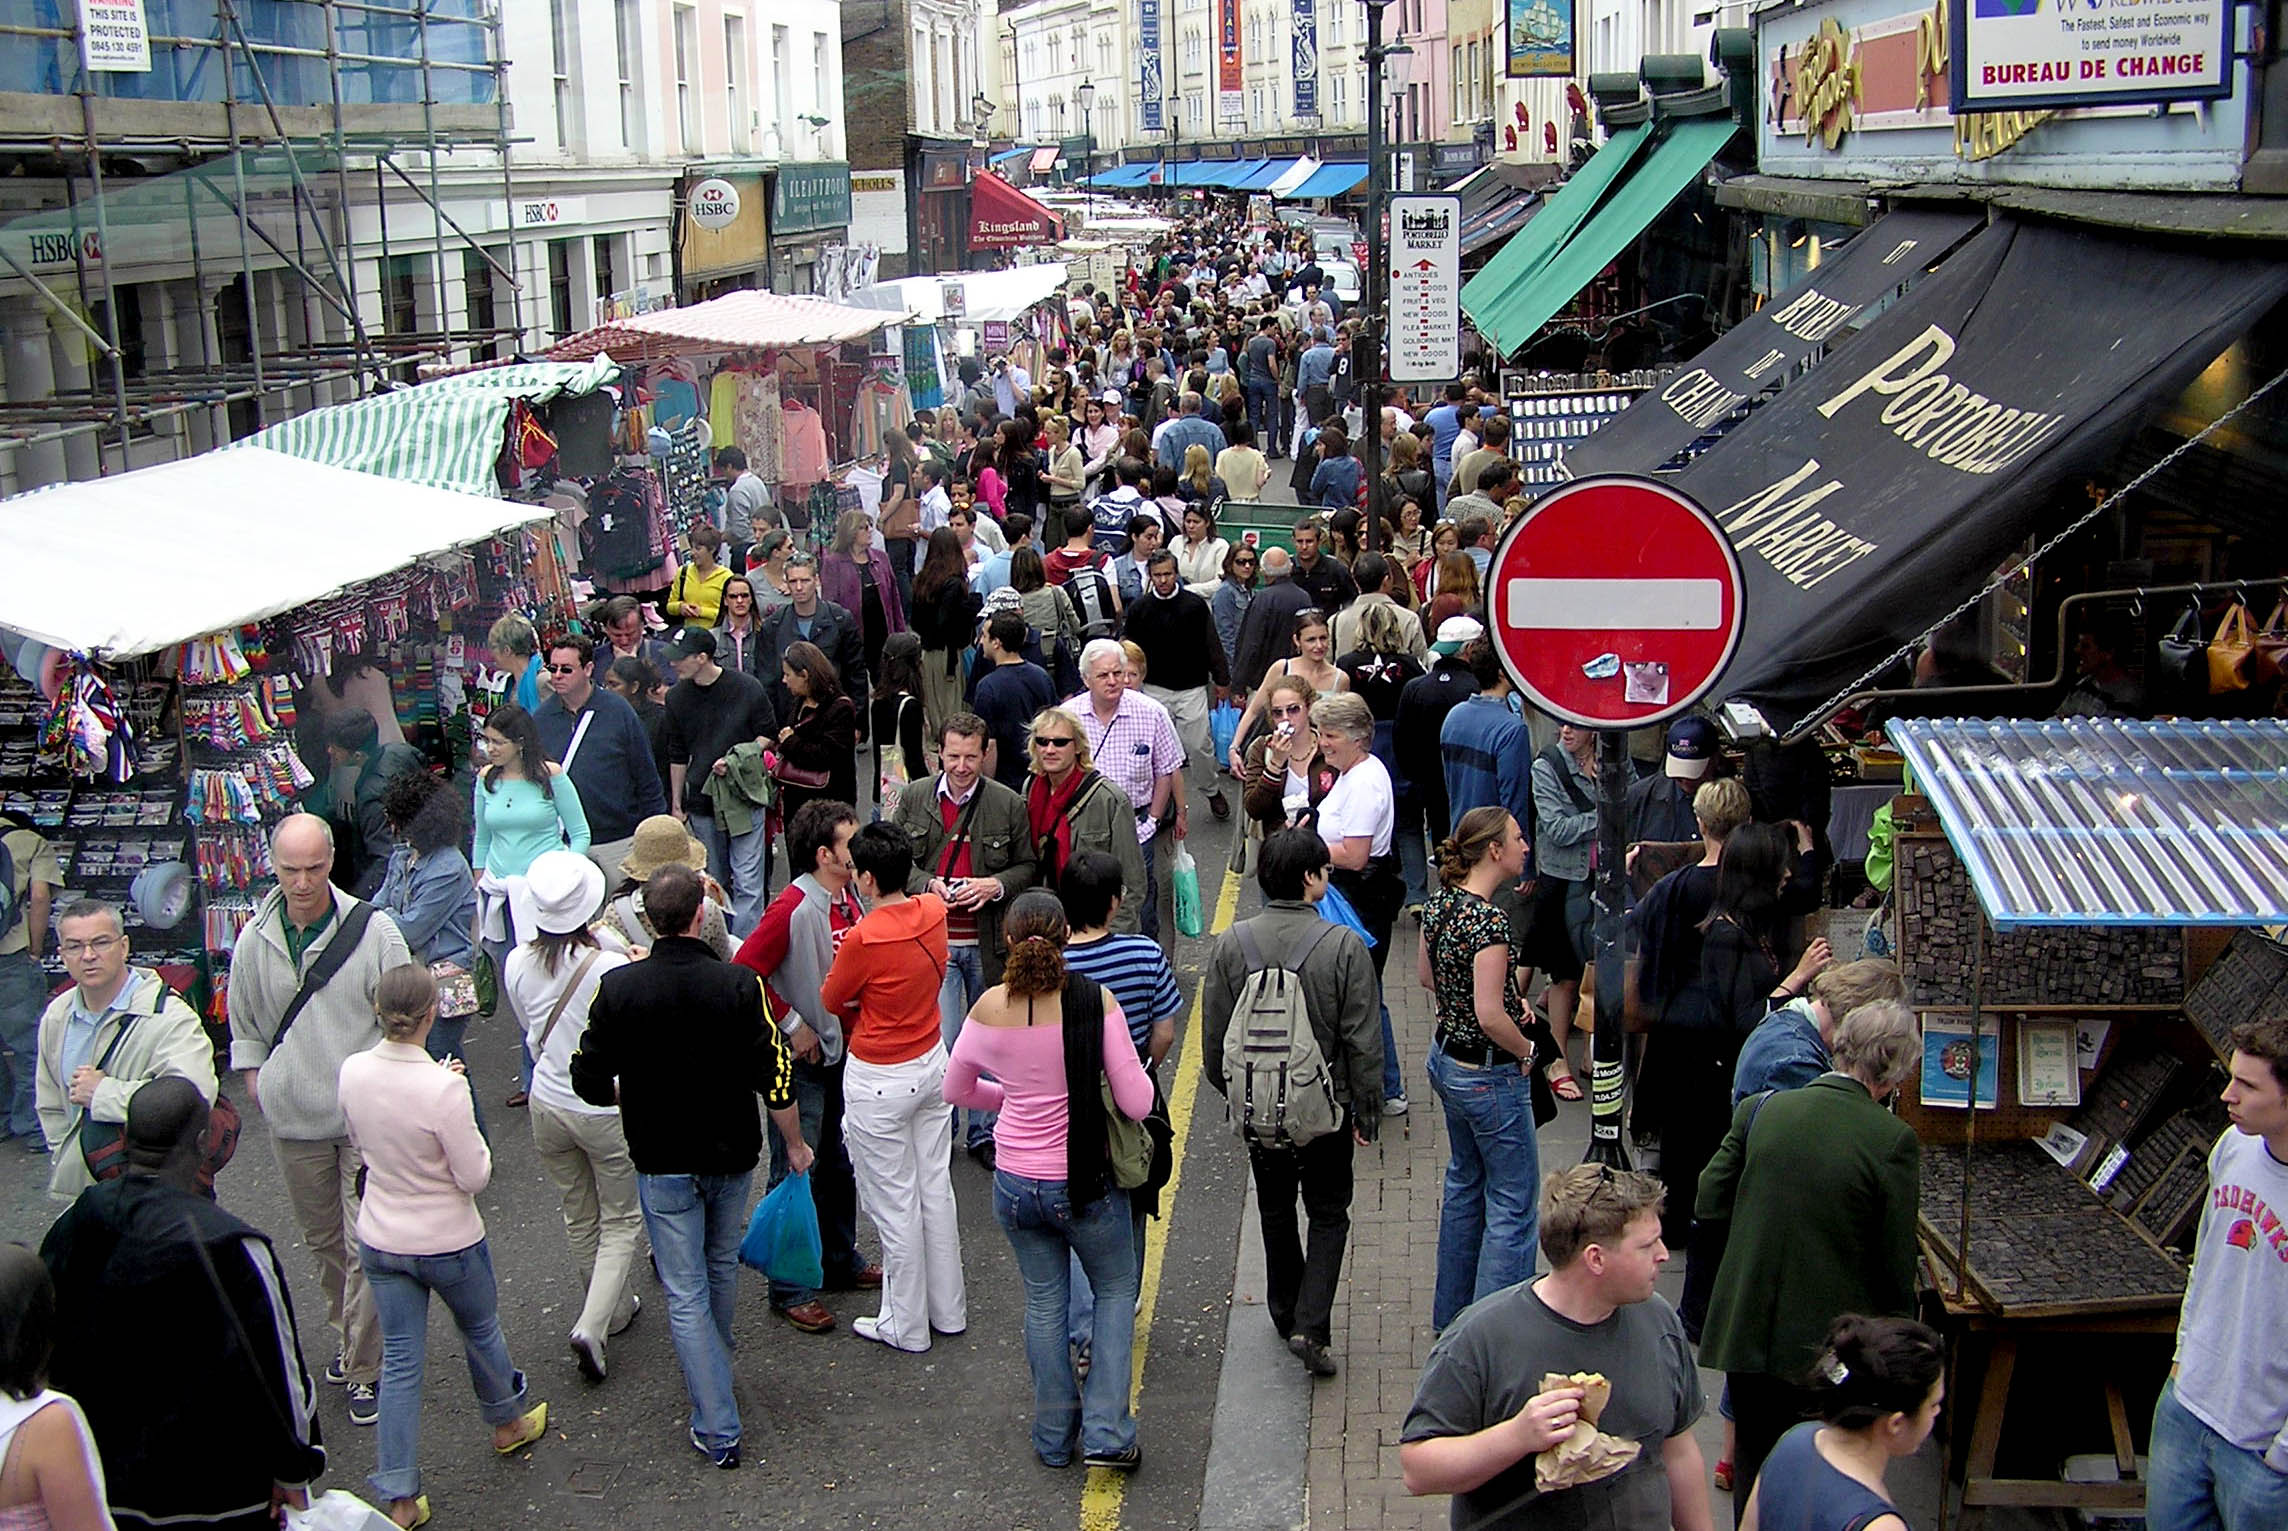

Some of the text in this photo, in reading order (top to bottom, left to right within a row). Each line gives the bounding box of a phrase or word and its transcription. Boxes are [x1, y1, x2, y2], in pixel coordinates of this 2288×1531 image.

[90, 8, 137, 21] THIS SITE IS
[2061, 12, 2210, 32] The Fastest, Safest and Economic way
[90, 25, 141, 38] PROTECTED
[2081, 32, 2182, 50] to send money Worldwide
[1982, 53, 2204, 85] BUREAU DE CHANGE
[525, 203, 547, 223] HSBC
[696, 202, 735, 216] HSBC
[977, 220, 1040, 234] Kingsland
[1402, 230, 1449, 239] PORTOBELLO
[28, 232, 79, 264] HSBC
[1406, 240, 1443, 249] MARKET
[1403, 271, 1439, 279] ANTIQUES
[1421, 310, 1448, 318] GOODS
[1421, 350, 1449, 358] GOODS
[1338, 357, 1349, 375] 8
[1714, 458, 1879, 590] MARKET
